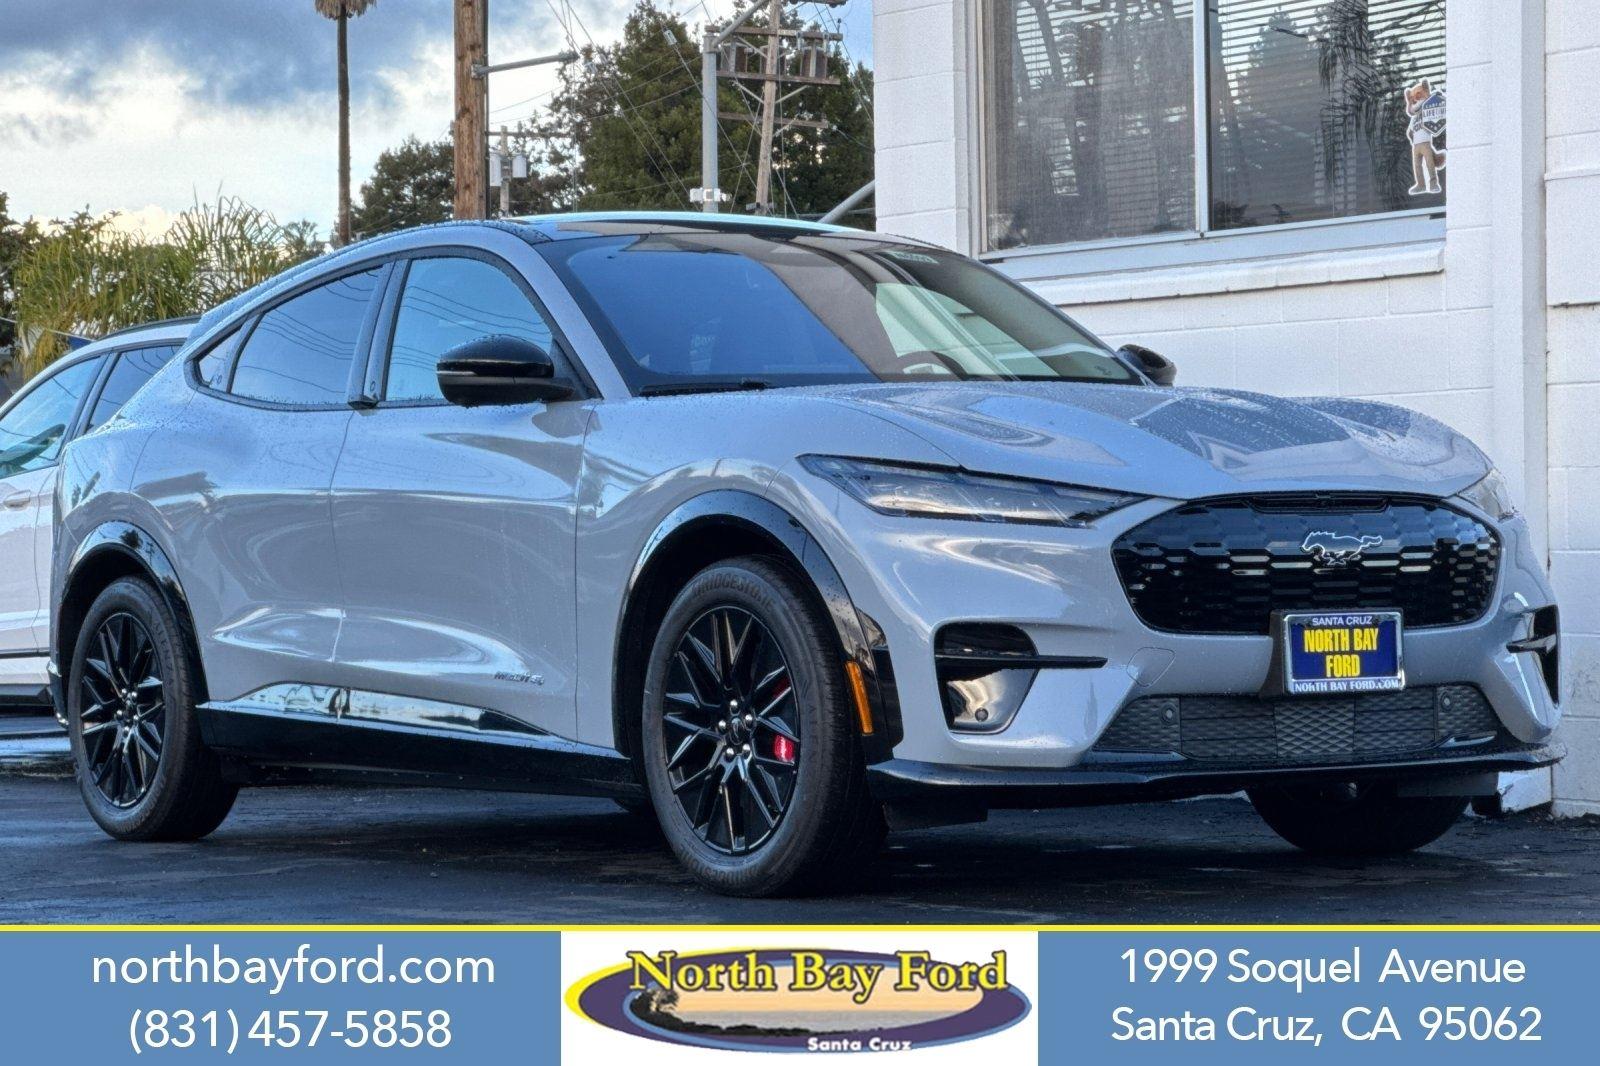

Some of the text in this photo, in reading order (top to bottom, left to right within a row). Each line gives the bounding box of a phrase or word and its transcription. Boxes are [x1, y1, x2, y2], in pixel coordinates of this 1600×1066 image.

[1311, 615, 1373, 626] SANTA CRUZ
[1303, 627, 1379, 653] NORTH BAY
[1325, 653, 1361, 678] FORD
[1295, 681, 1328, 692] NORTH
[1330, 680, 1348, 691] BAY
